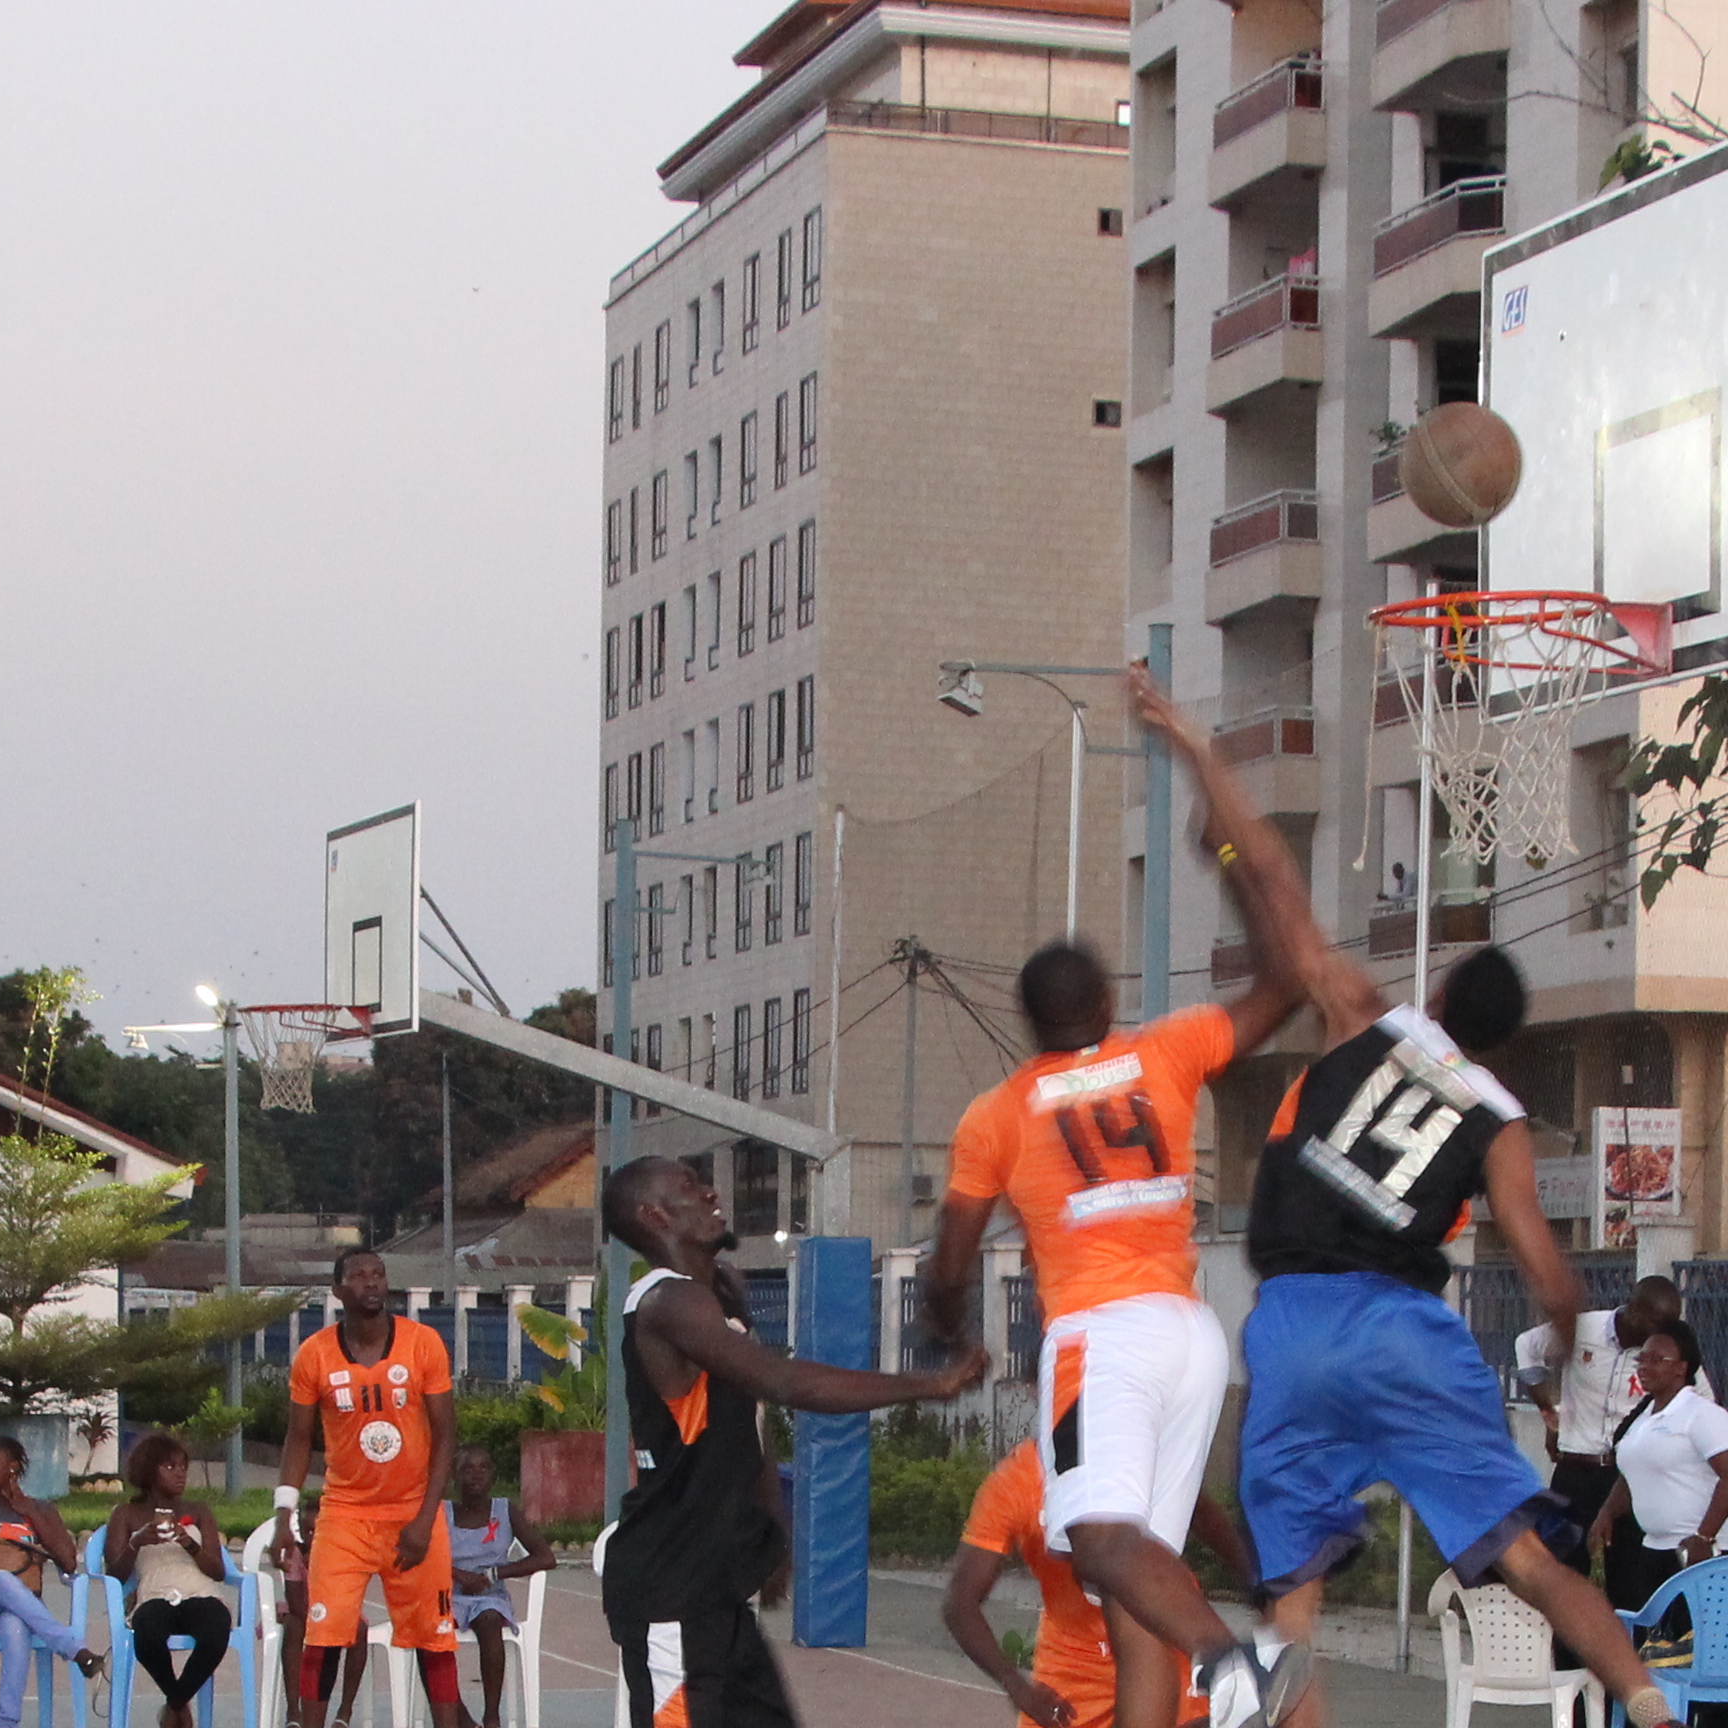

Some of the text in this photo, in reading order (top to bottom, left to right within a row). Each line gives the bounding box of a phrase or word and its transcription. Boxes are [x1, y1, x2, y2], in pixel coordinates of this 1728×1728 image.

[1084, 1054, 1138, 1074] MINING
[1055, 1089, 1171, 1182] 14
[1326, 1059, 1463, 1198] 14
[361, 1384, 383, 1412] 11
